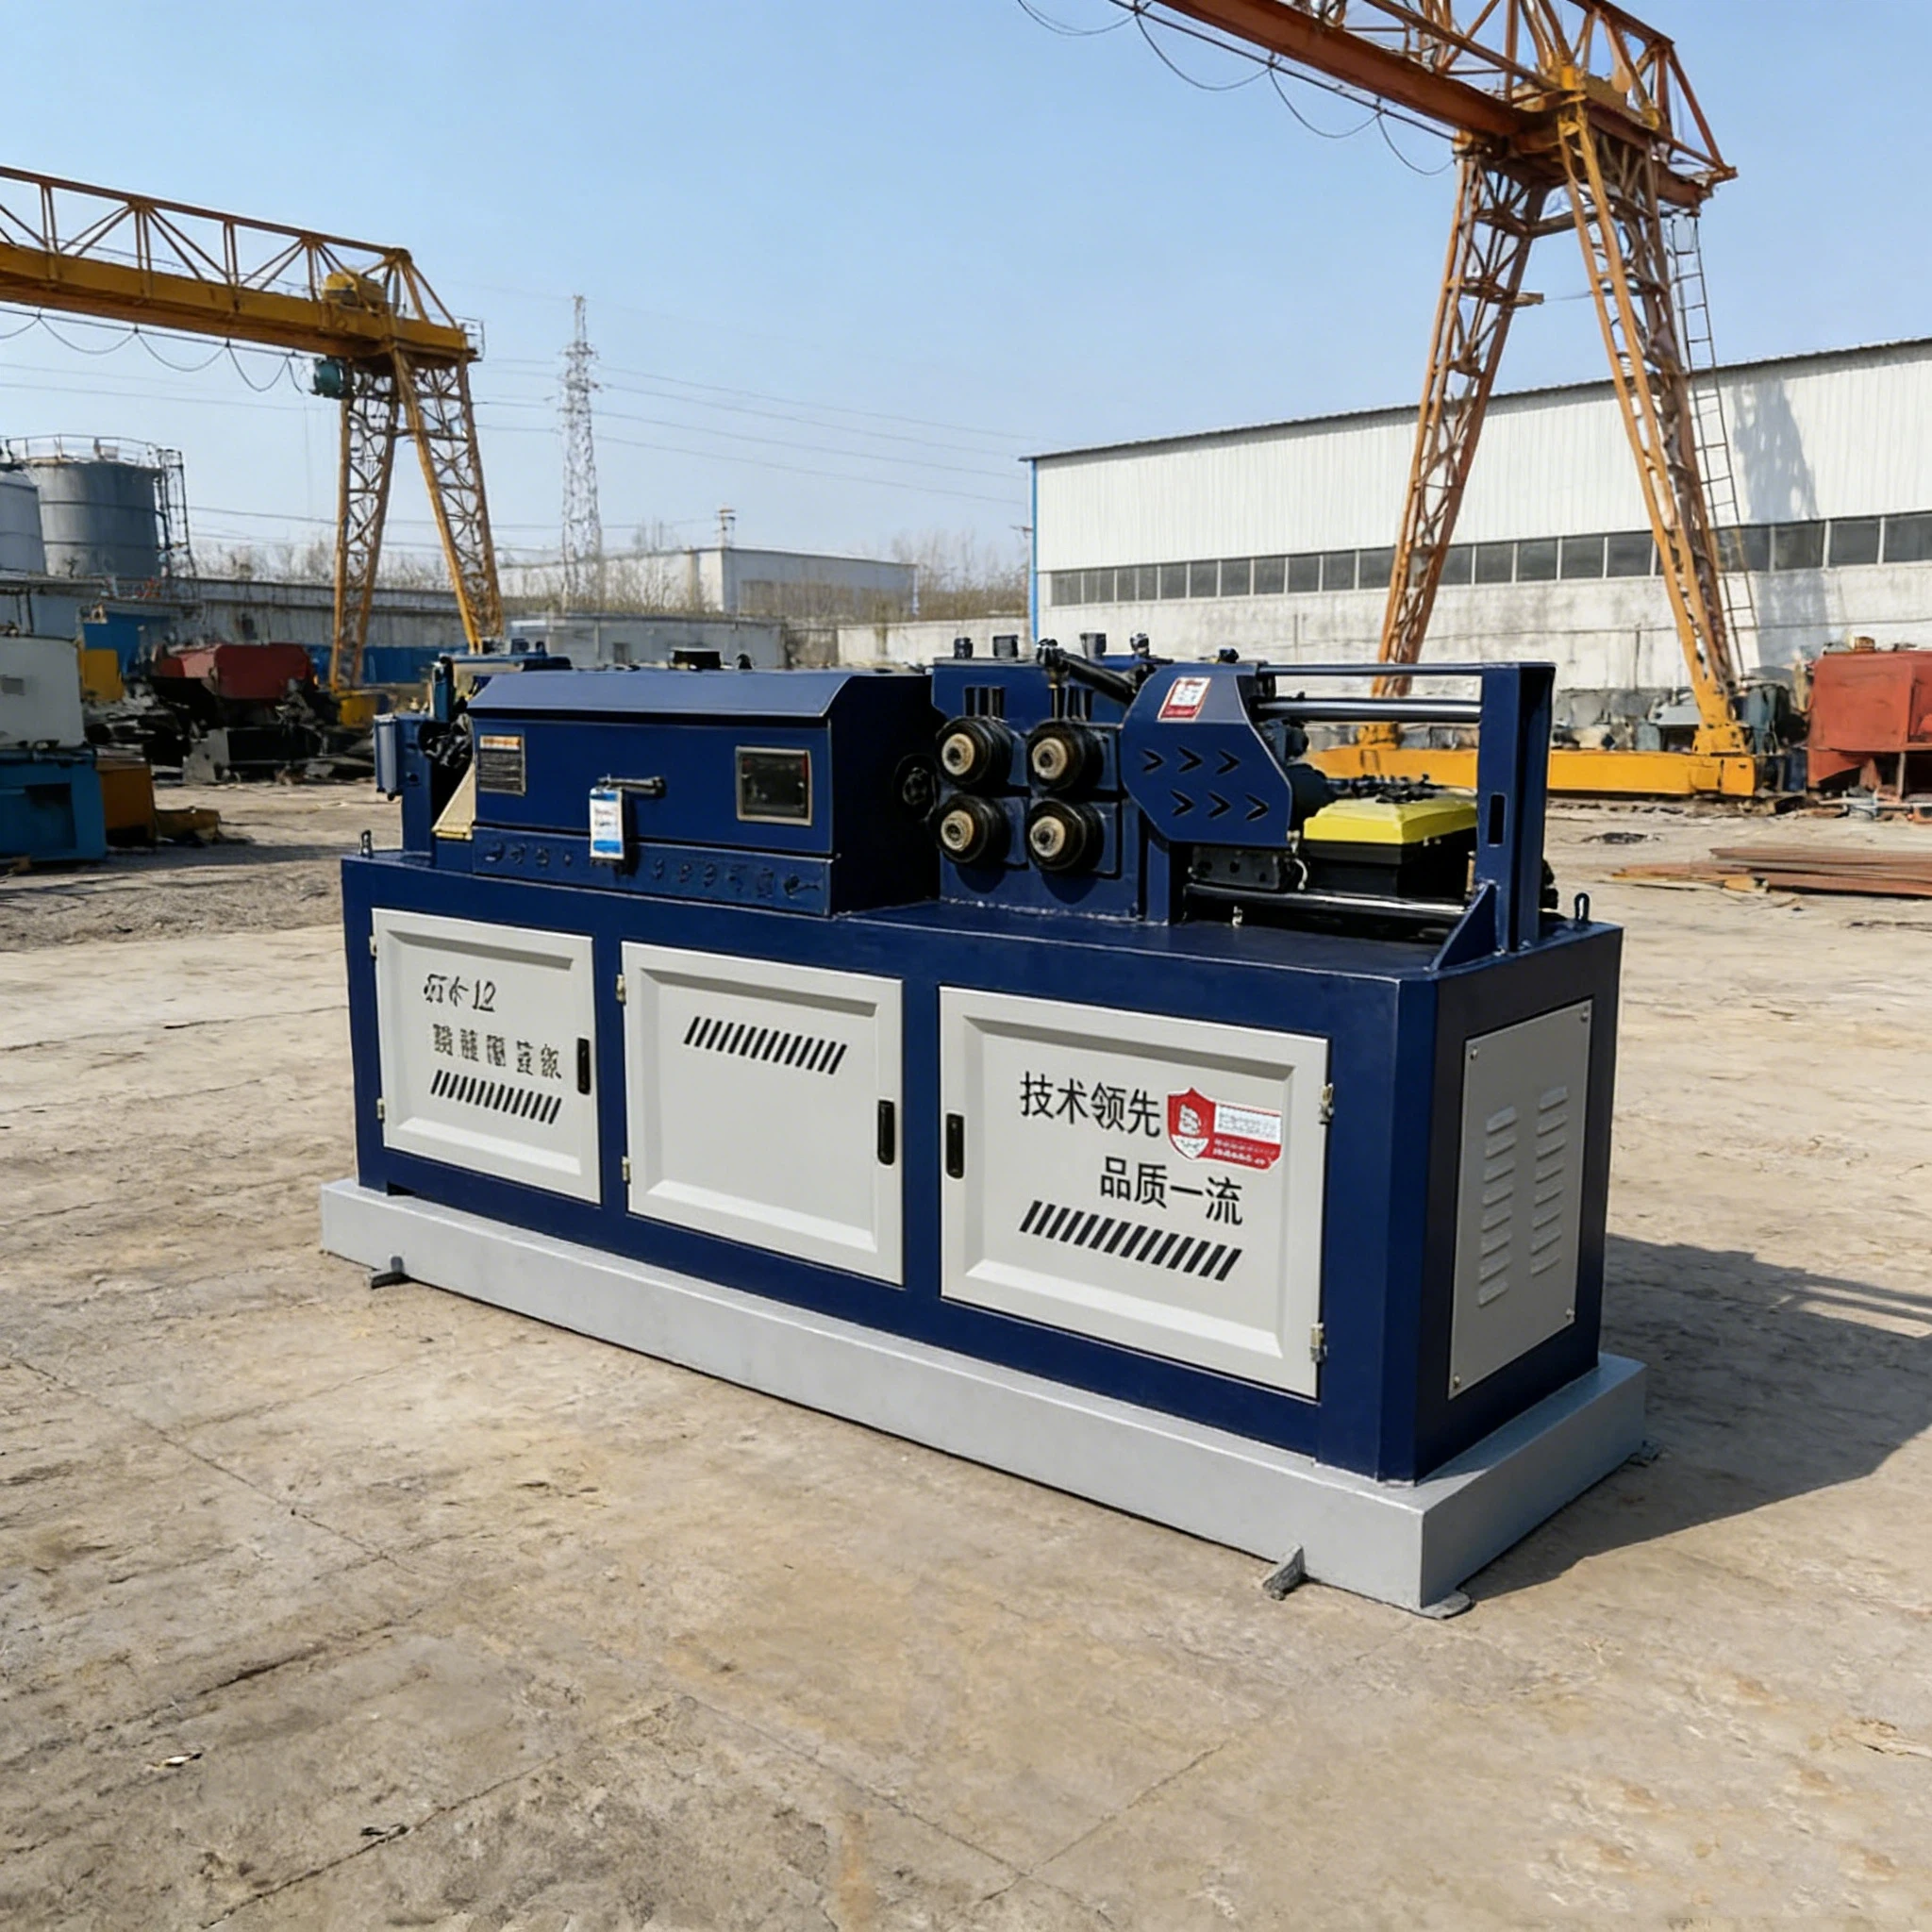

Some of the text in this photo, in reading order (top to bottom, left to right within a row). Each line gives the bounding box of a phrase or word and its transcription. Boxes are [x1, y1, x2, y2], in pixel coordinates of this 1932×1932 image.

[1020, 1071, 1161, 1138] 技术领先
[1100, 1157, 1243, 1225] 品质一流
